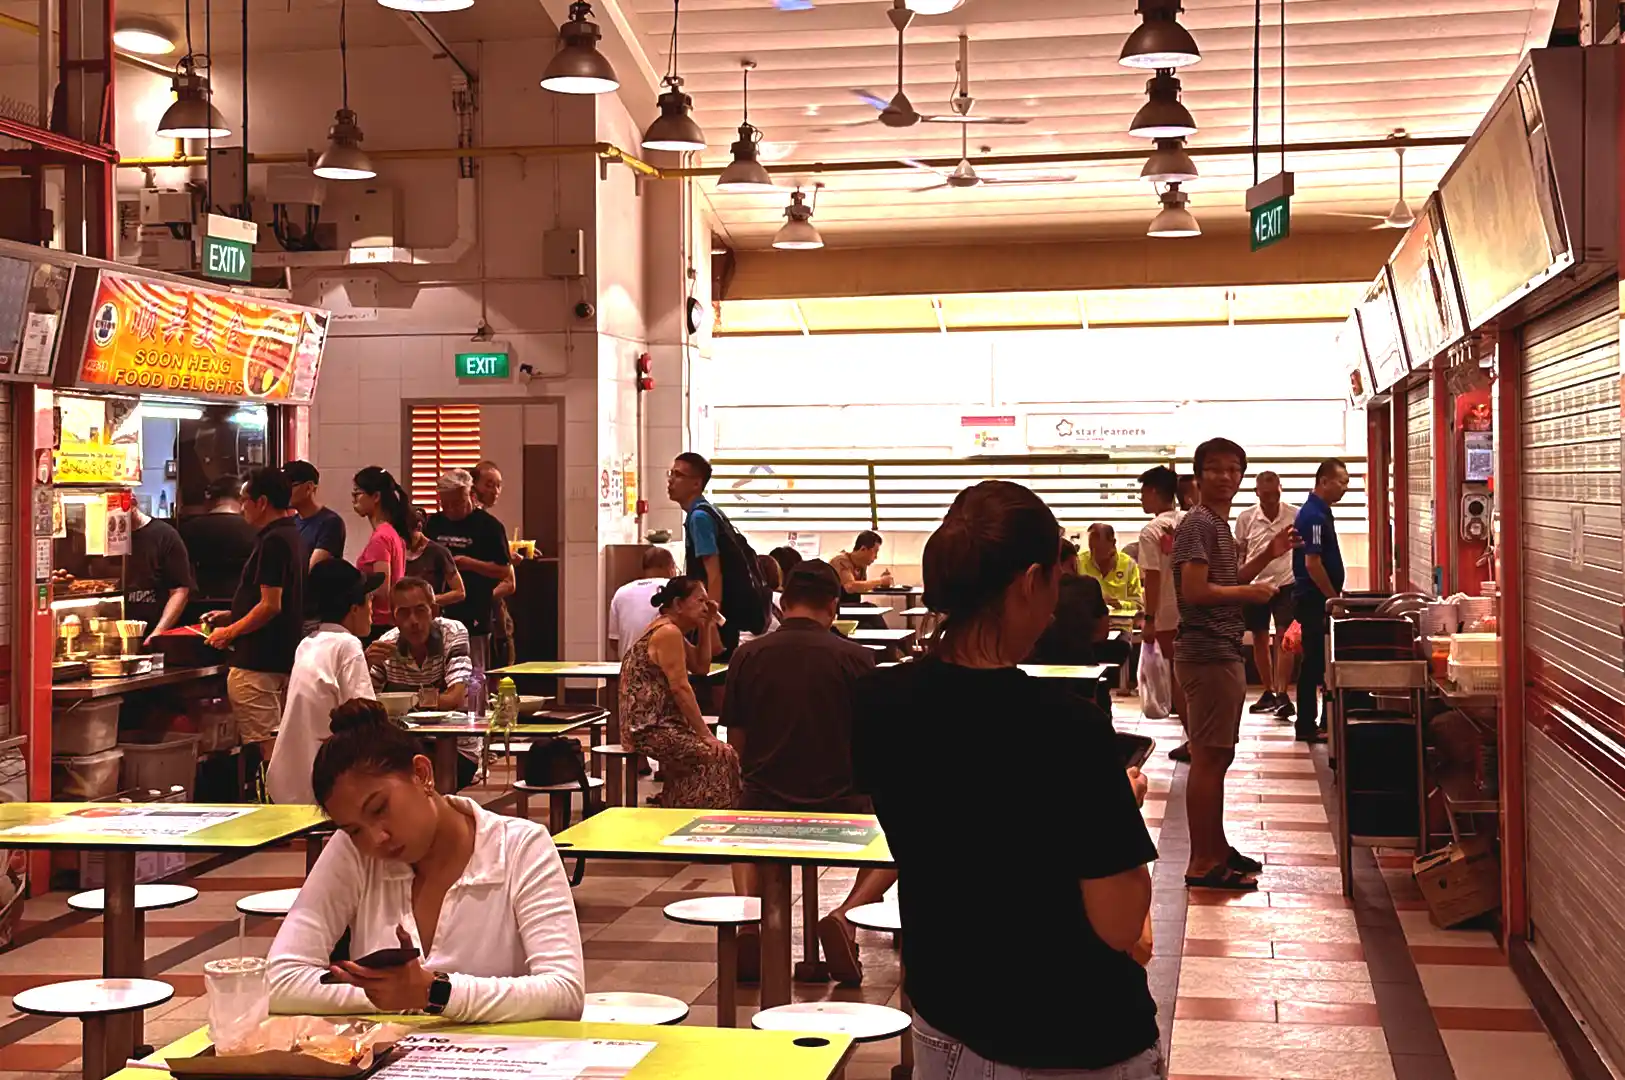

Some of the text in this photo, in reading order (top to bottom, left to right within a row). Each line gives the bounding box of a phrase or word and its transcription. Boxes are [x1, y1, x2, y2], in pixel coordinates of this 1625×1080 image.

[1260, 205, 1283, 242] EXIT
[209, 243, 239, 274] EXIT
[134, 350, 231, 374] SOON HENG
[466, 356, 498, 375] EXIT
[114, 369, 244, 395] FOOD DELIGHTS
[1075, 425, 1146, 436] star learners
[398, 1044, 509, 1055] gether?
